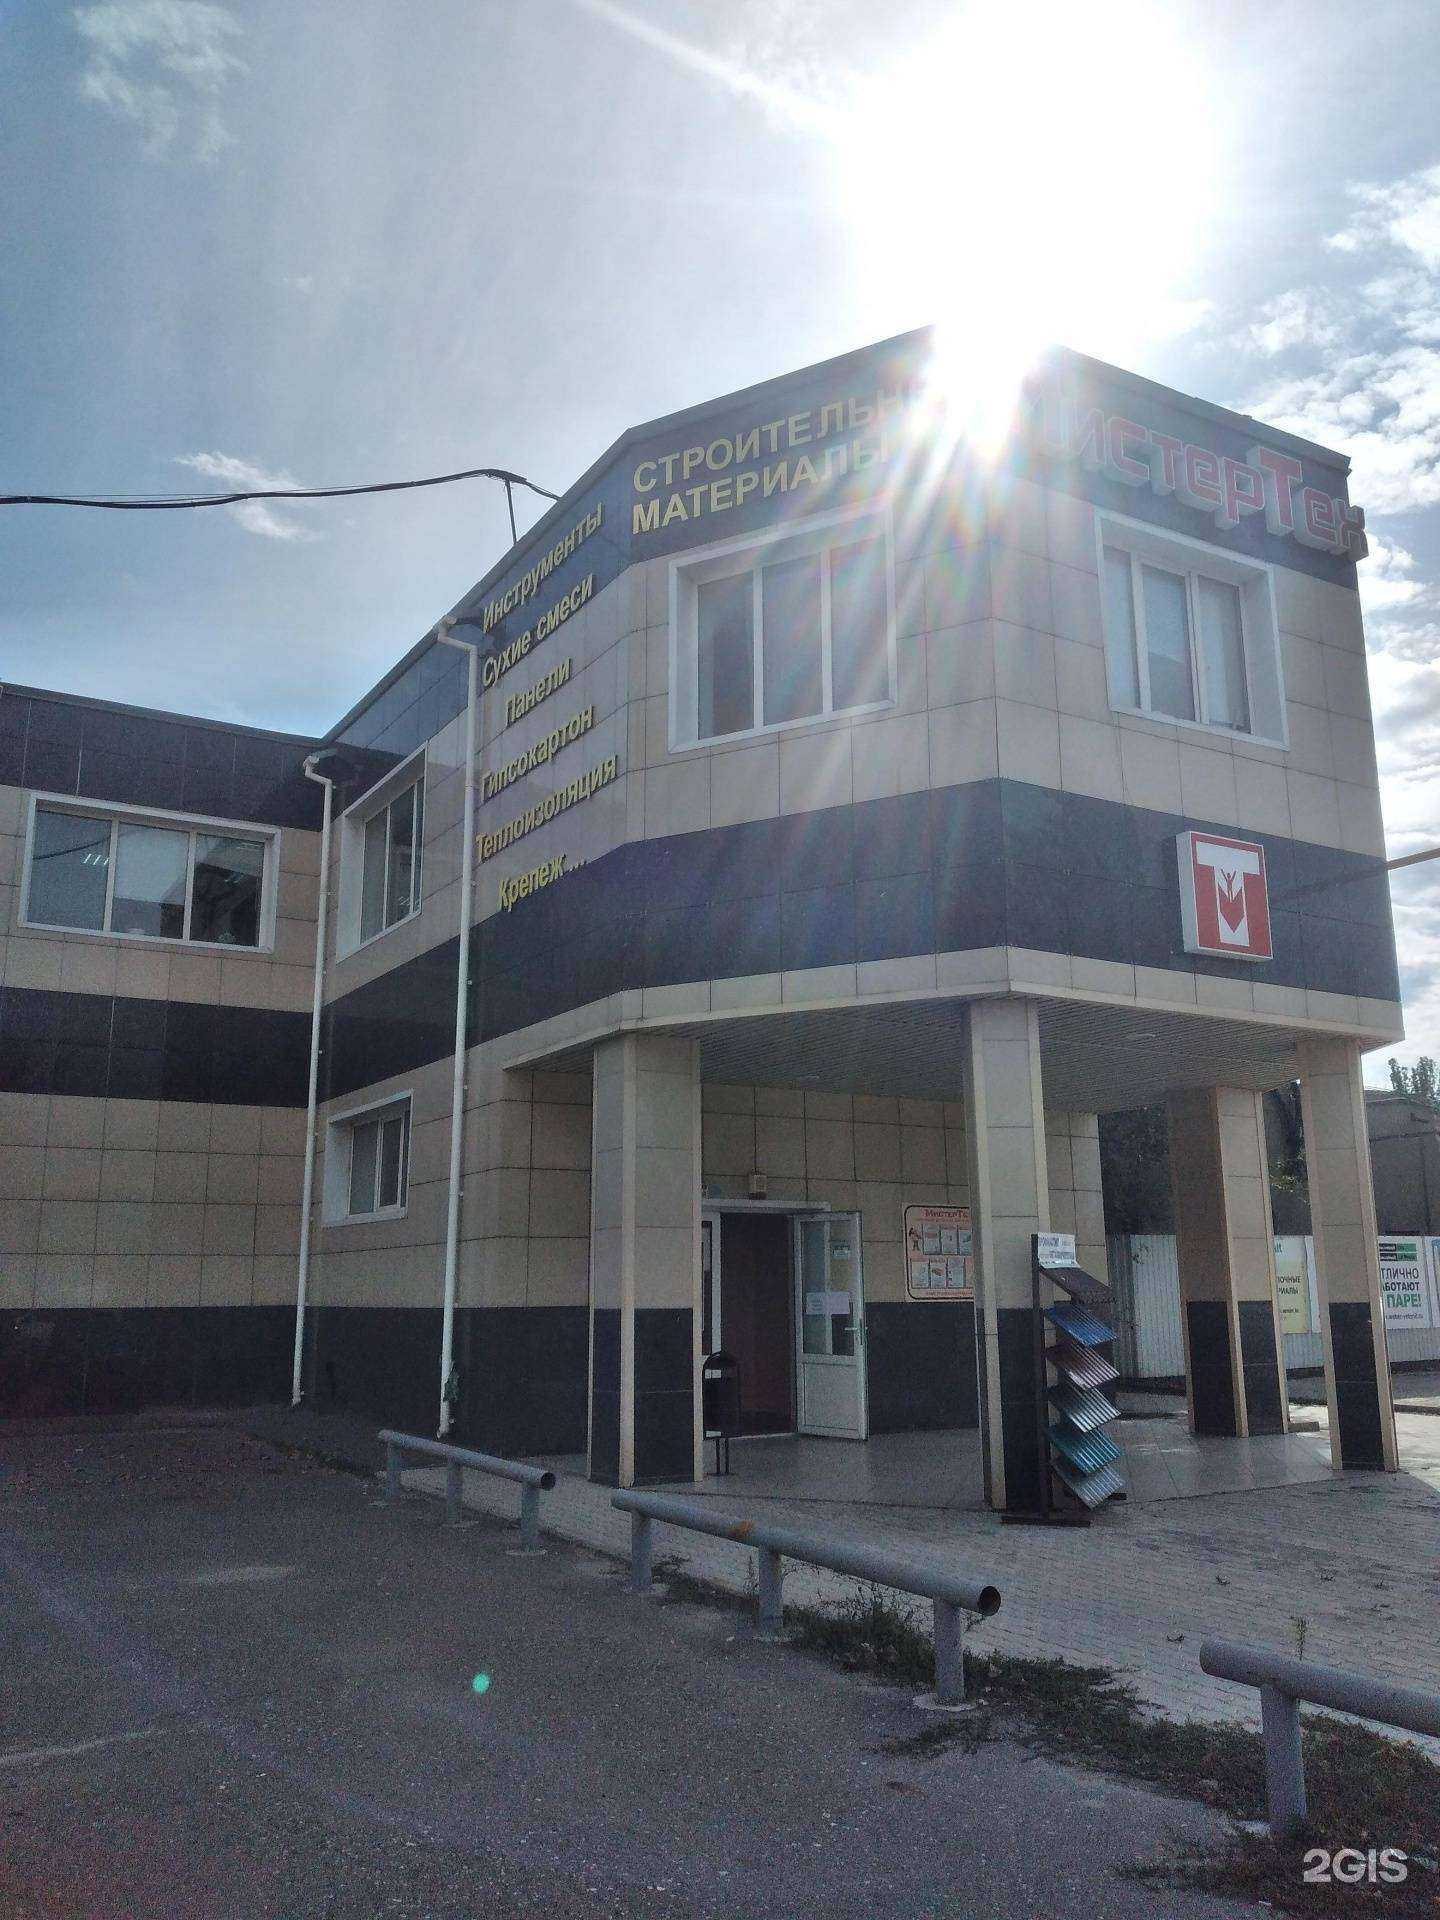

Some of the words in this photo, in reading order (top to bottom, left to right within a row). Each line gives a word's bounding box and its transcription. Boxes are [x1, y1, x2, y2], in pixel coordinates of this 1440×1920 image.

[632, 430, 889, 535] МАТЕРИАЛЫ
[483, 502, 603, 634] Инструменты
[482, 630, 532, 688] Сухие
[536, 573, 594, 641] смеси
[505, 657, 572, 727] Панели
[478, 704, 595, 803] Гипсокартон
[475, 755, 618, 863] Теплоизоляция
